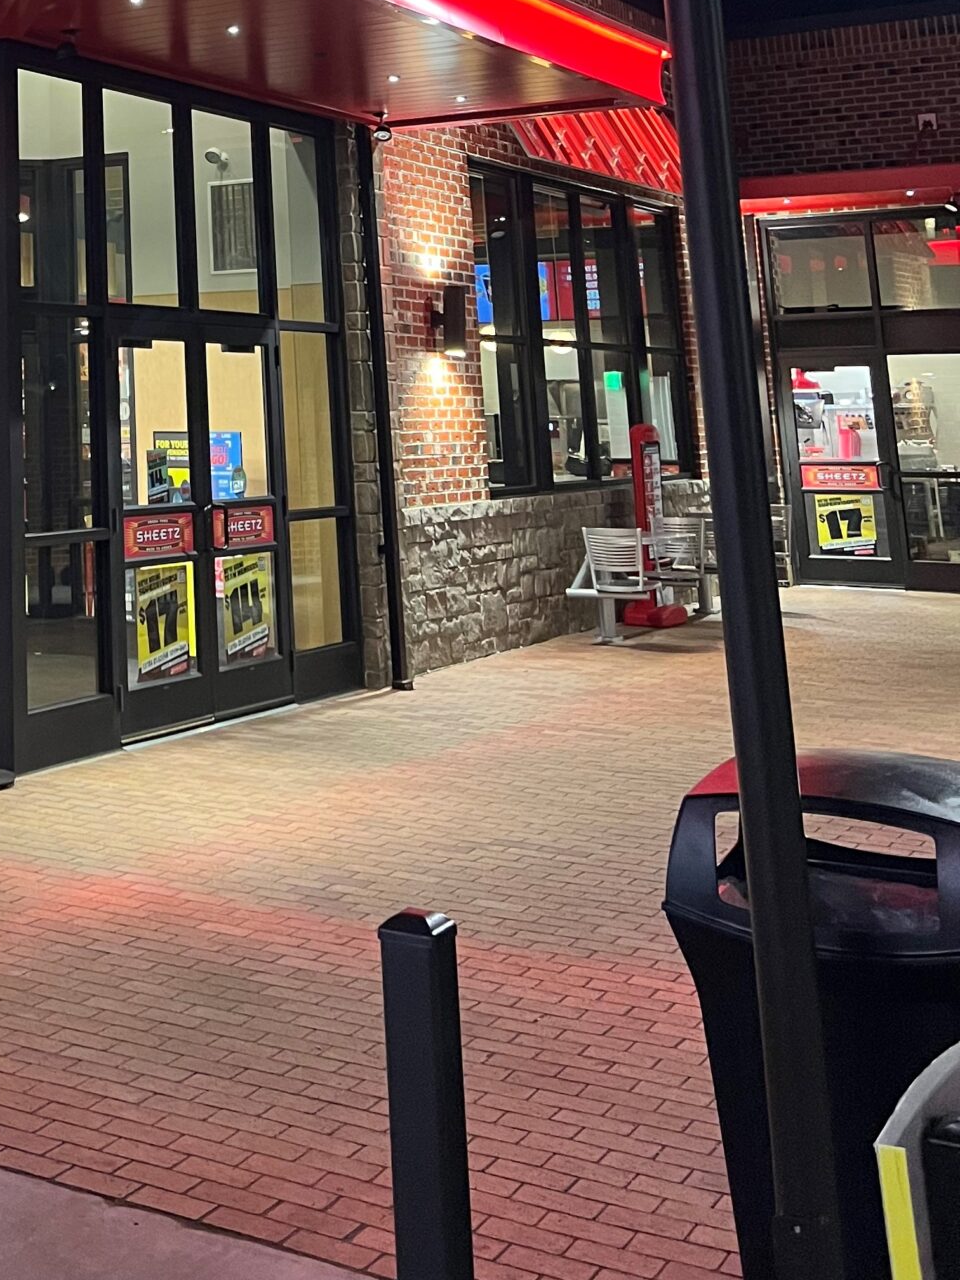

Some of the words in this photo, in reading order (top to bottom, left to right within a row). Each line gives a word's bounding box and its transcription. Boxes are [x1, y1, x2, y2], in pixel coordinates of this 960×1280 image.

[156, 439, 170, 448] FOR
[816, 472, 867, 481] SHEETZ
[136, 527, 180, 542] SHEETZ
[818, 508, 862, 540] $17
[224, 578, 263, 635] $14
[138, 590, 178, 654] $17
